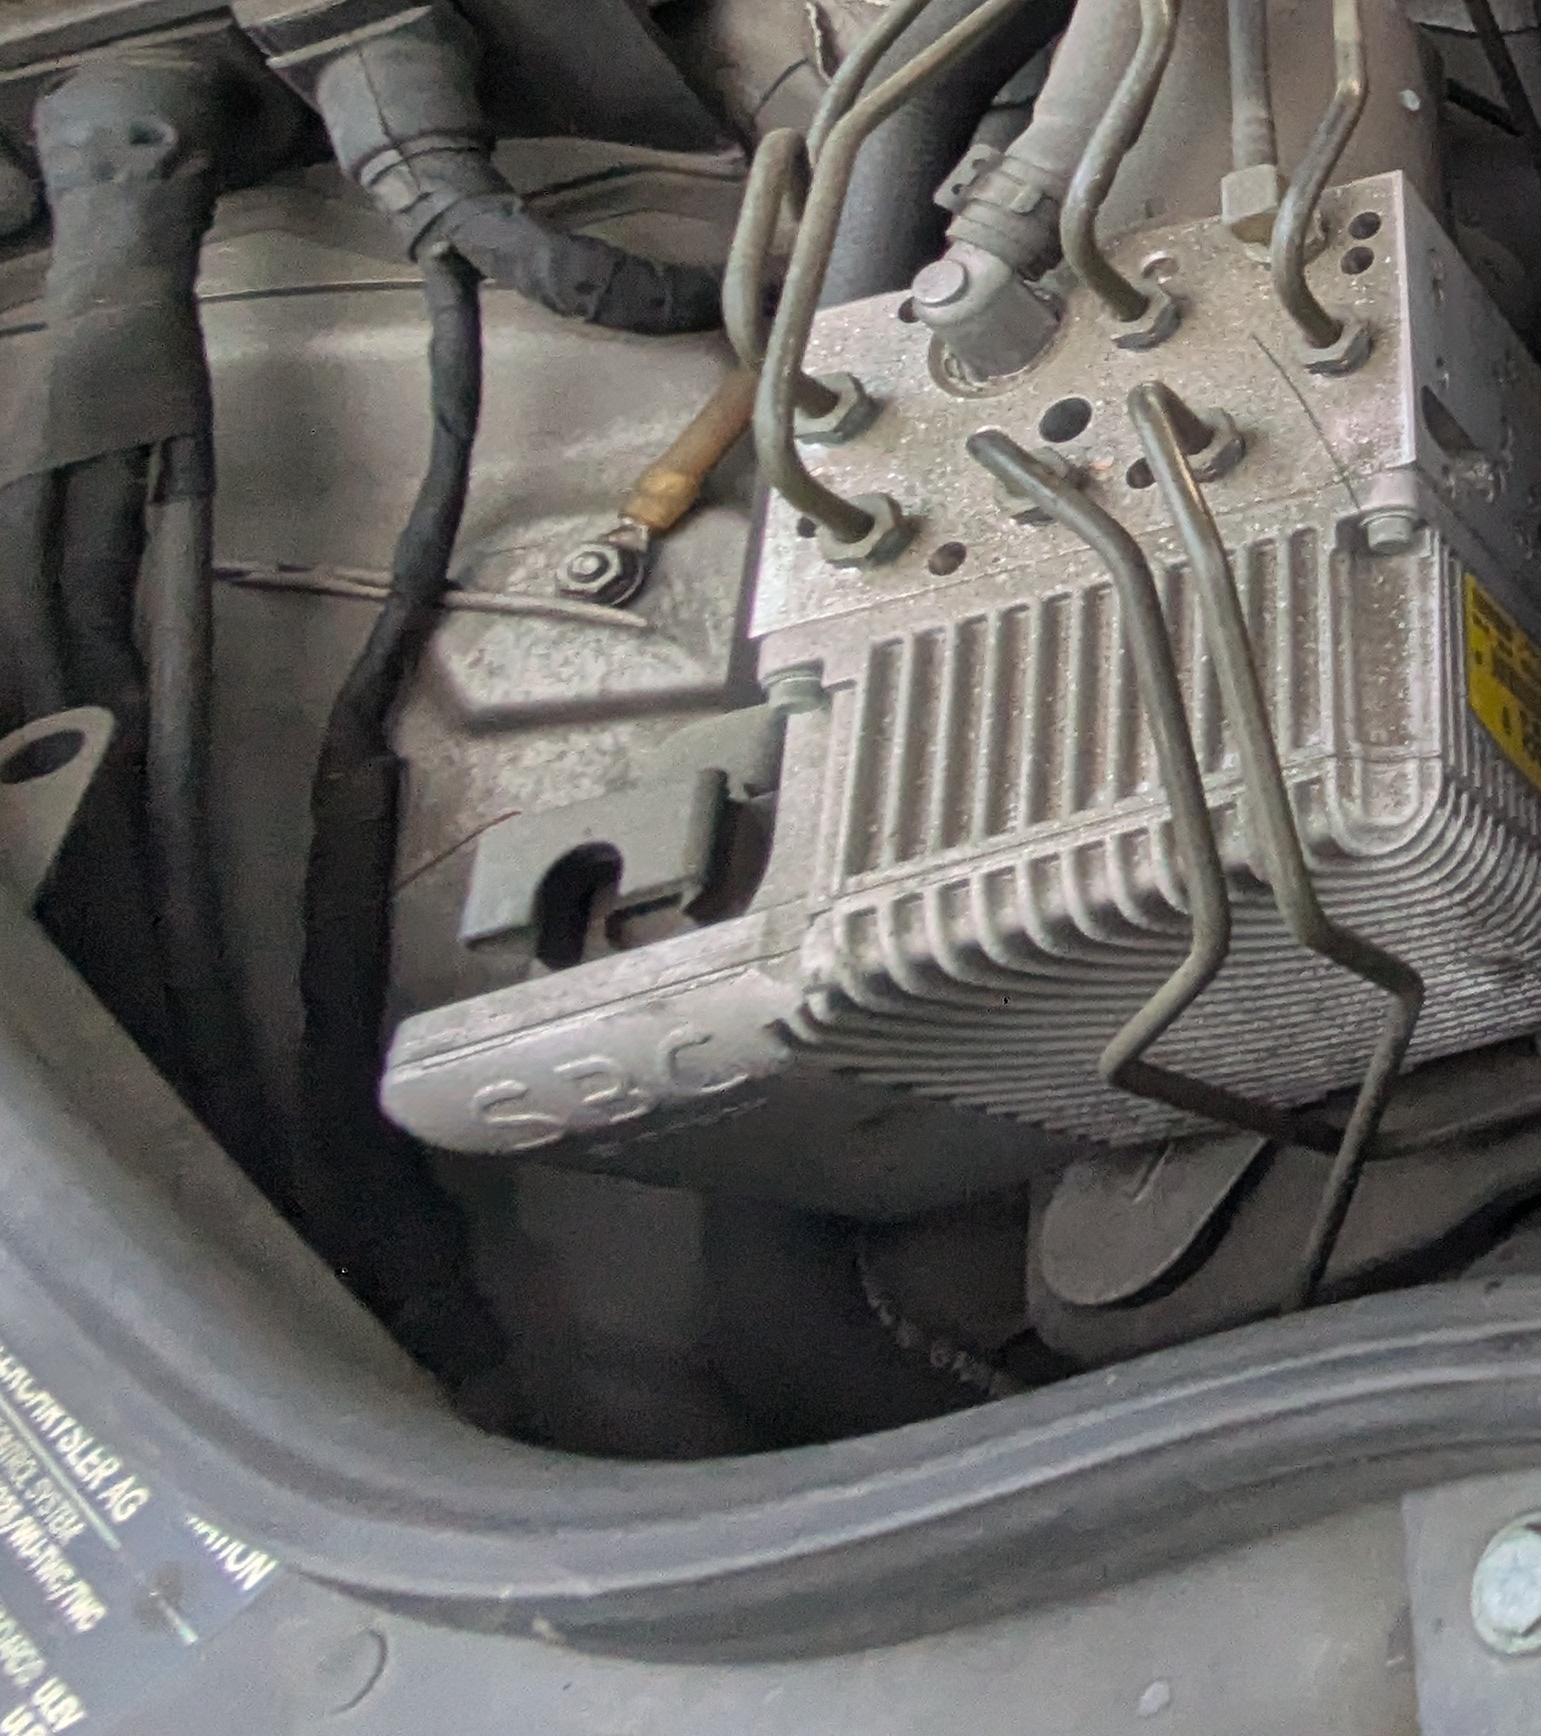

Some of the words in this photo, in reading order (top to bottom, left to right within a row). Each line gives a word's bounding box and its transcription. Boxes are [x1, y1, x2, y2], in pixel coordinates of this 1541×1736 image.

[472, 1021, 750, 1152] SBC
[24, 1476, 87, 1547] SYSTEM
[96, 1475, 151, 1524] AG
